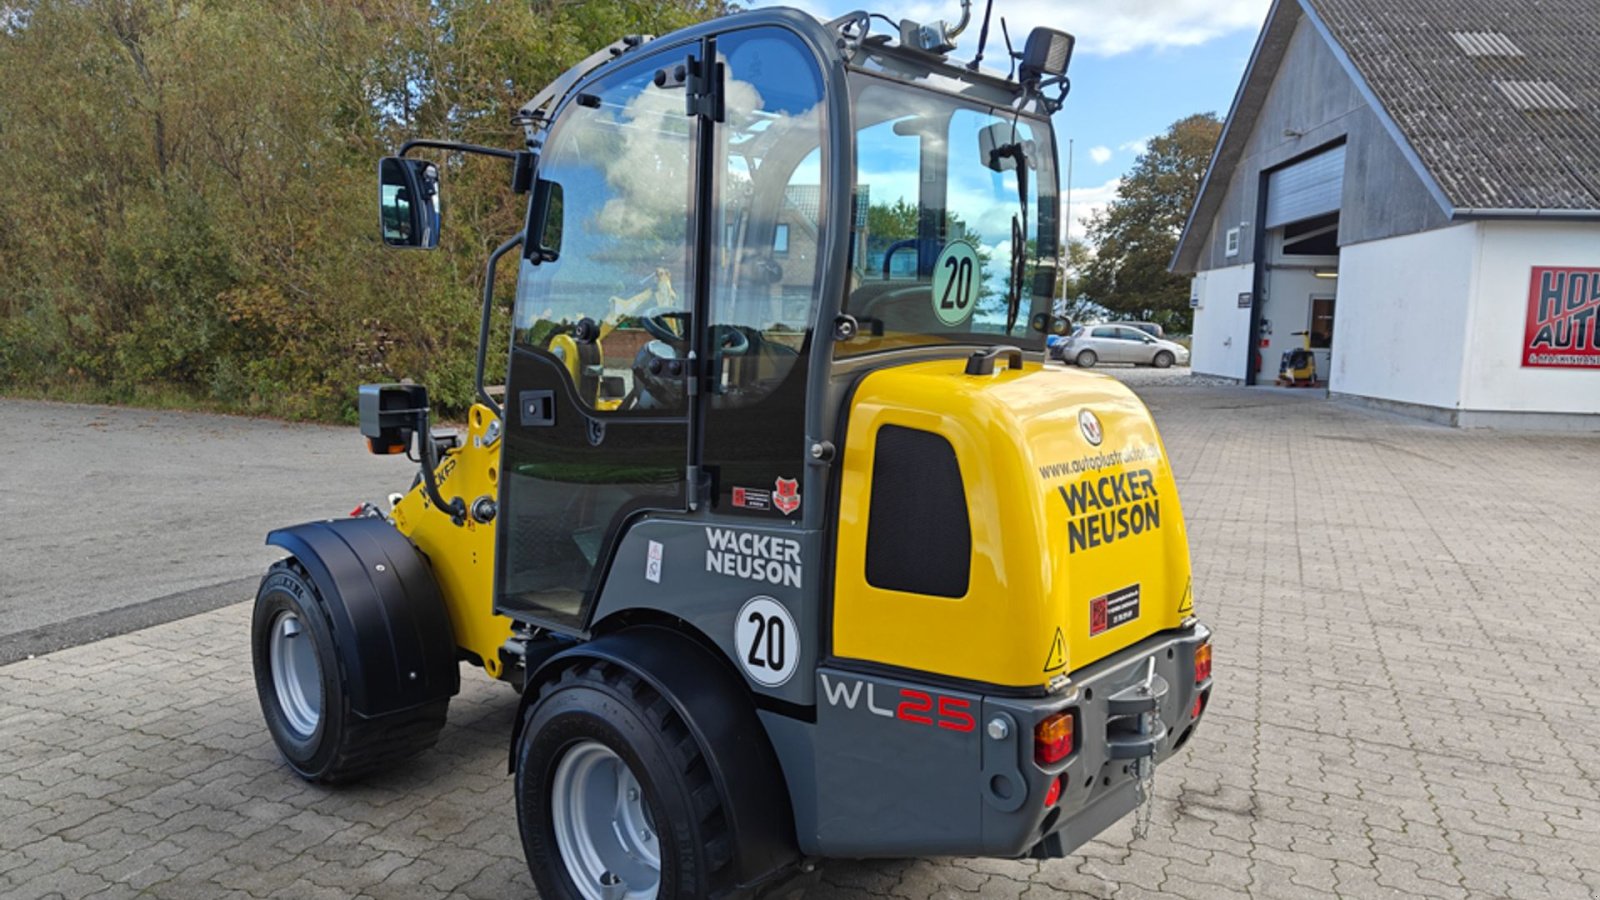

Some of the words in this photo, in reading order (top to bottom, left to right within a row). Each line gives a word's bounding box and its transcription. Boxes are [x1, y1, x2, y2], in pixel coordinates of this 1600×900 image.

[941, 255, 973, 310] 20
[1058, 468, 1158, 516] WACKER
[705, 527, 802, 564] WACKER
[1067, 499, 1160, 554] NEUSON
[706, 550, 802, 588] NEUSON
[748, 611, 785, 671] 20
